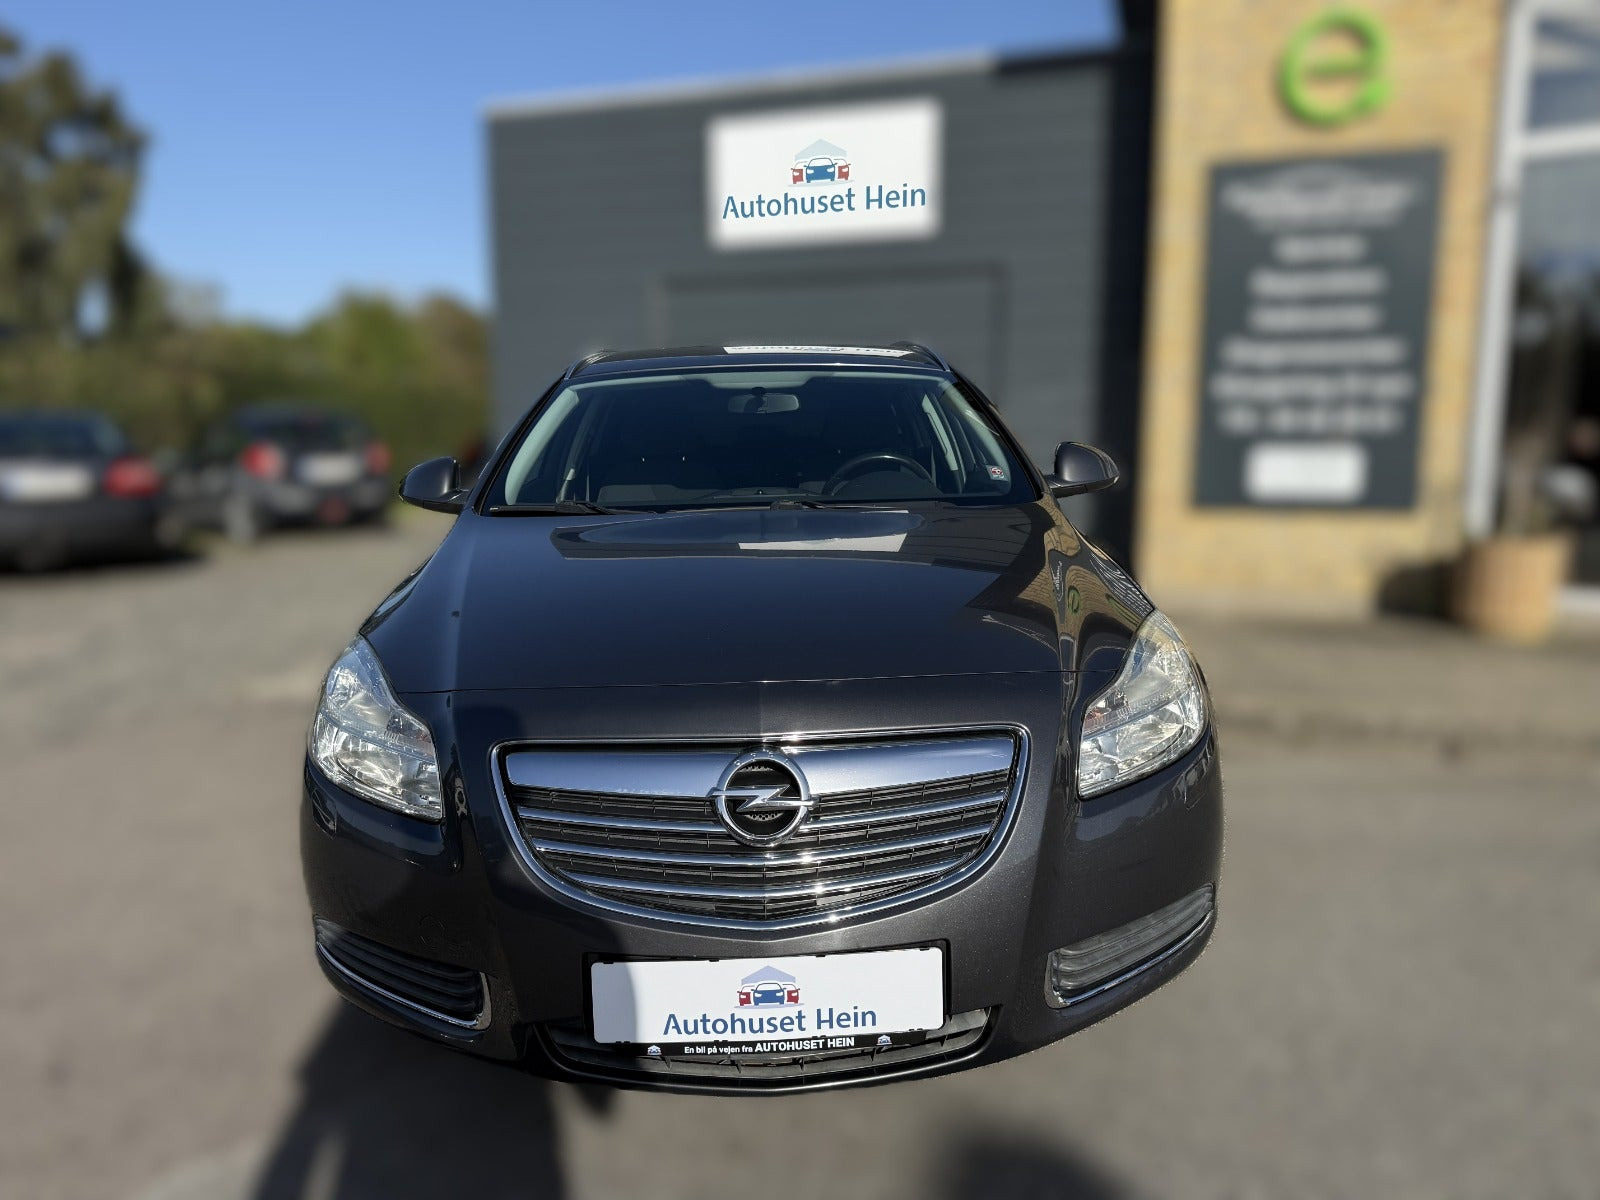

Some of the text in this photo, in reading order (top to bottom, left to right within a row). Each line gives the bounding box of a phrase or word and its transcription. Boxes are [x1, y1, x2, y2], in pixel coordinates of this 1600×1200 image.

[722, 183, 926, 219] Autohuset Hein
[663, 1006, 877, 1035] Autohuset Hein
[684, 1036, 855, 1055] En bil på vejen fra AUTOHUSET HEIN
